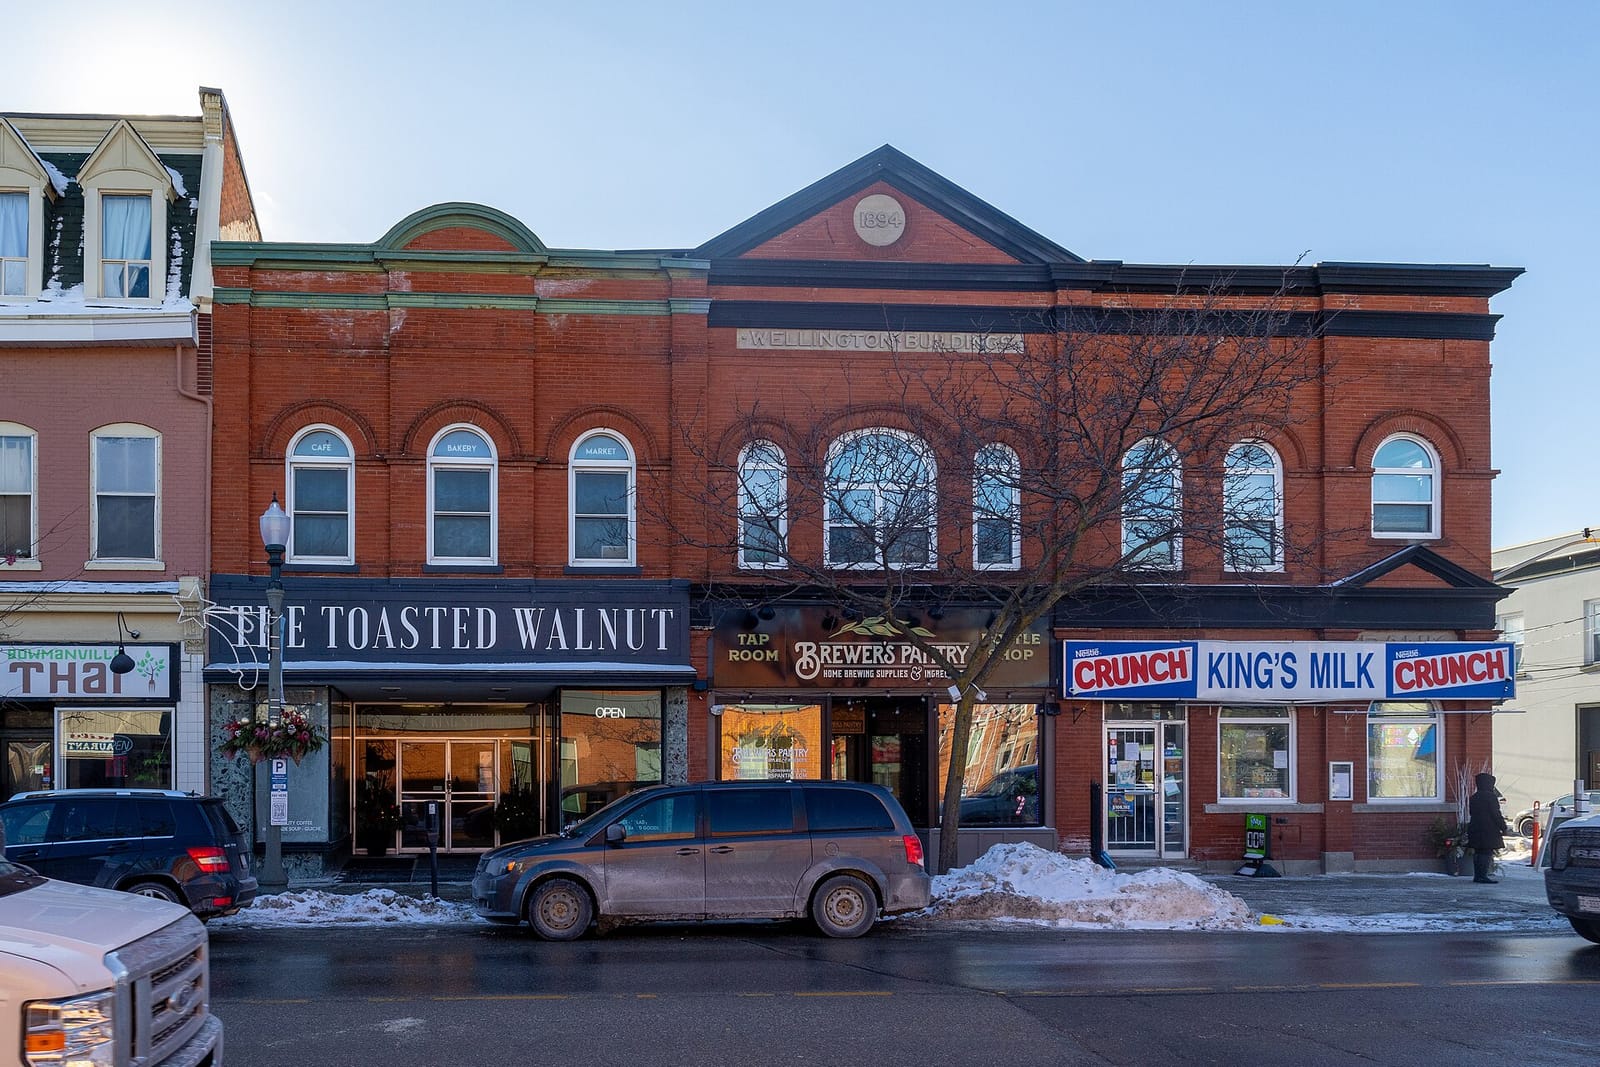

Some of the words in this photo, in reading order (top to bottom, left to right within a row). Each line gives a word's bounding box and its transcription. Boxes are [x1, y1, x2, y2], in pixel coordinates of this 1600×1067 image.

[860, 211, 902, 228] 1894
[749, 330, 893, 349] WELLINGTON
[447, 443, 477, 453] BAKERY
[585, 447, 616, 456] MARKET
[321, 606, 498, 650] TOASTED
[512, 607, 674, 651] WALNUT
[737, 633, 770, 646] TAP
[728, 649, 779, 662] ROOM
[794, 641, 895, 680] BREWER'S
[823, 669, 842, 679] HOME
[844, 669, 875, 679] BREWING
[876, 669, 909, 679] SUPPLIES
[910, 666, 923, 681] &
[1074, 649, 1188, 690] CRUNCH
[1208, 651, 1298, 690] KING'S
[1310, 651, 1375, 690] MILK
[1394, 650, 1505, 691] CRUNCH
[595, 707, 626, 719] OPEN
[275, 761, 284, 773] P
